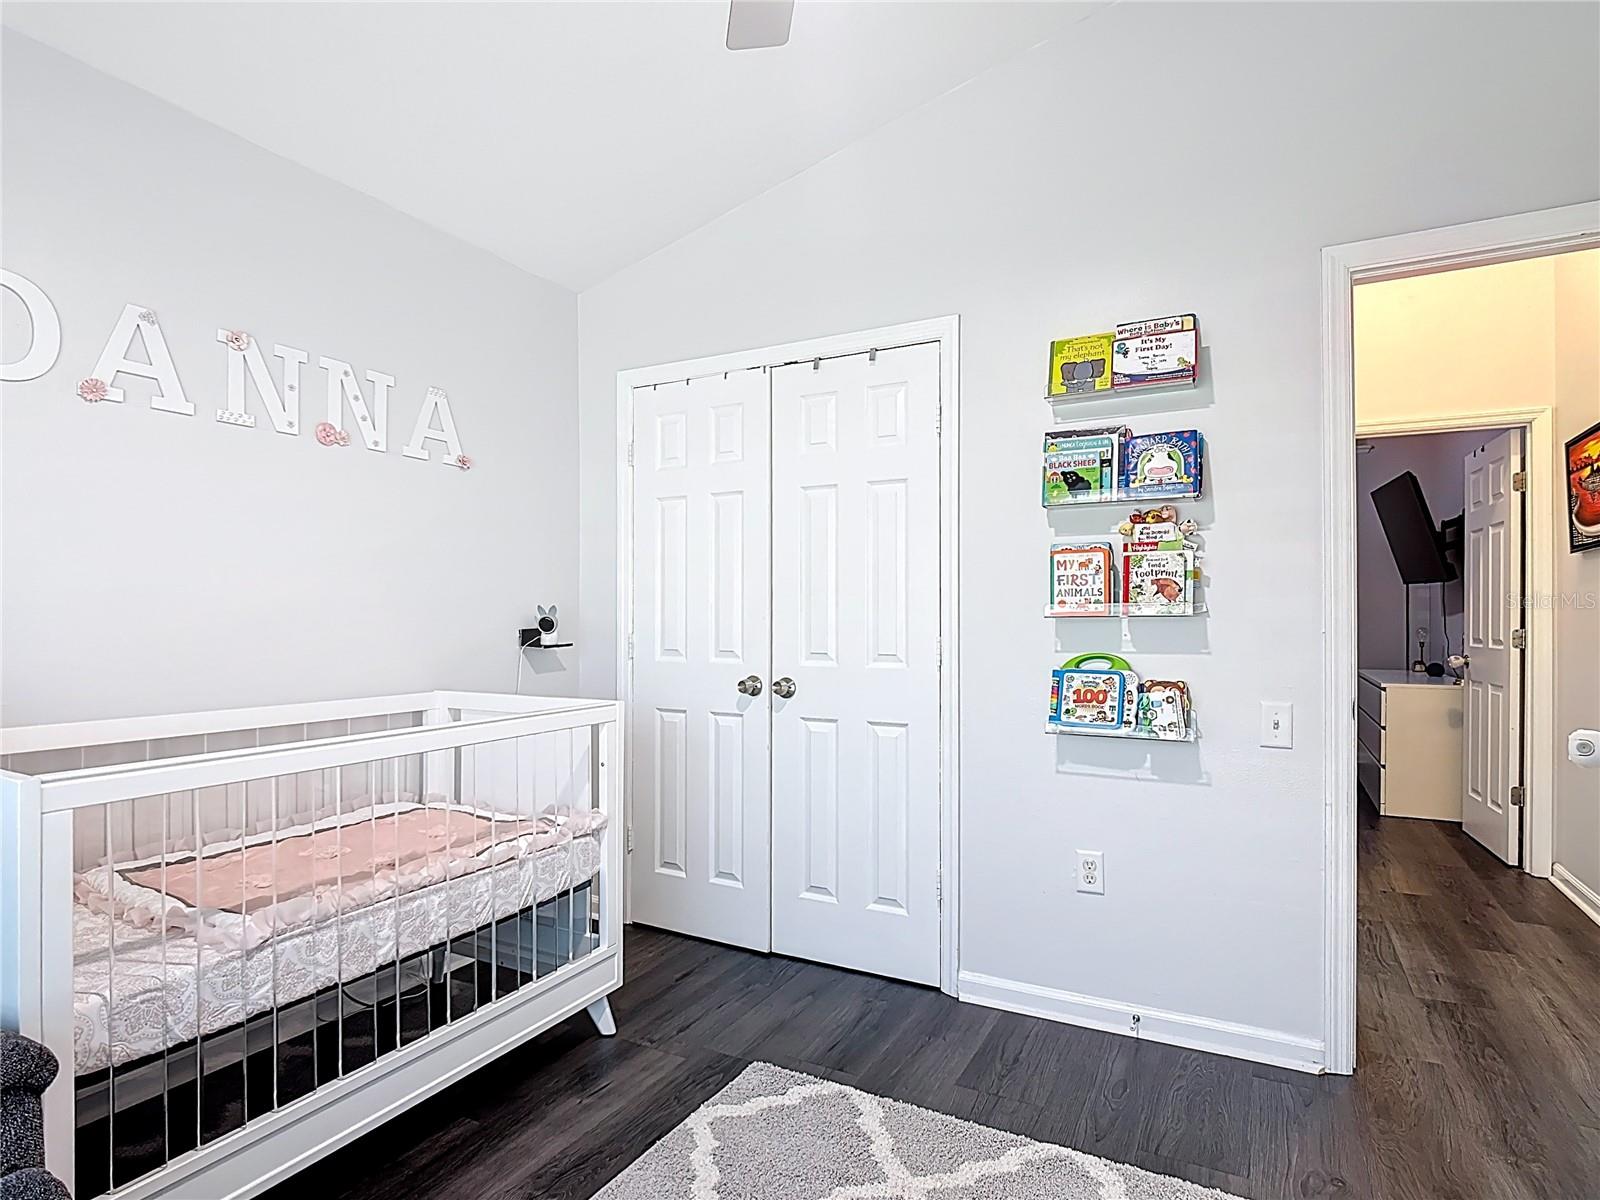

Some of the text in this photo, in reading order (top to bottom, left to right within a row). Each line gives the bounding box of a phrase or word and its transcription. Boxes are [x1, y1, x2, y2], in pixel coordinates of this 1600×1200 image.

[1117, 319, 1180, 336] Where is Baby's
[1141, 336, 1167, 345] It's My
[1066, 344, 1088, 353] That's
[1135, 341, 1173, 353] First Day!
[1073, 350, 1105, 361] elephant
[1048, 458, 1097, 470] BLACK SHEEP
[1056, 574, 1098, 587] FIRST
[1056, 587, 1103, 598] ANIMALS
[1073, 689, 1108, 704] 100
